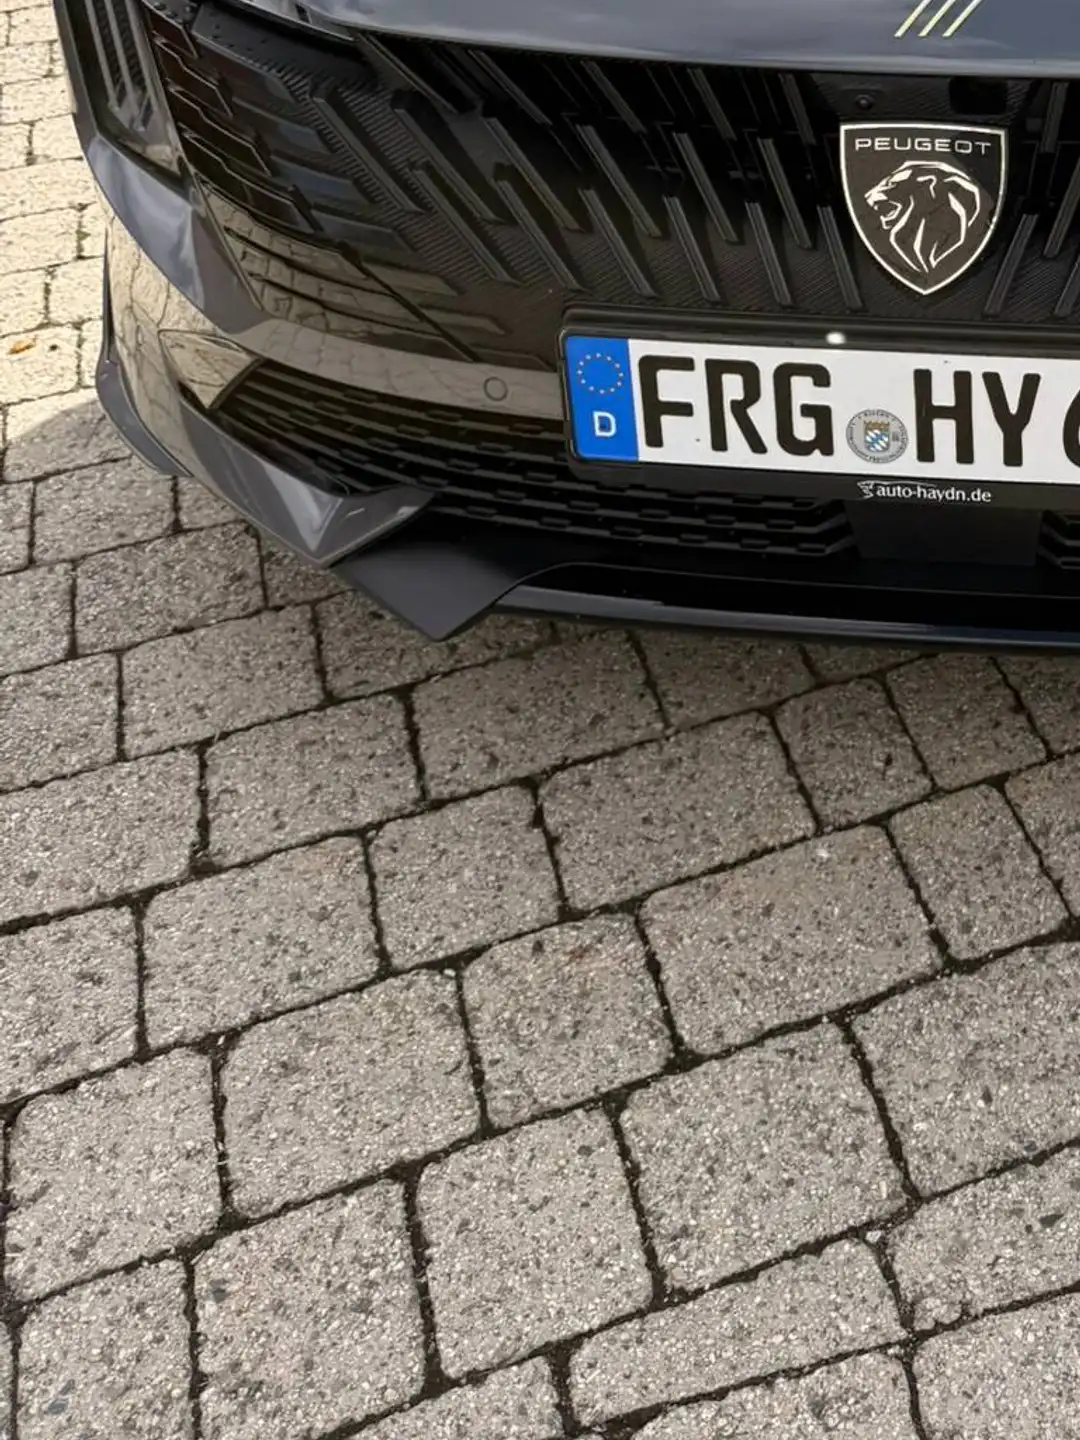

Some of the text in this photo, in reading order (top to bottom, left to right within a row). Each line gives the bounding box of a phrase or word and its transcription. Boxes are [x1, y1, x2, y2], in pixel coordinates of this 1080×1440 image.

[854, 136, 992, 156] PEUGEOT
[638, 354, 835, 458] FRG
[913, 368, 1042, 467] HY
[593, 411, 617, 438] D
[875, 483, 993, 503] auto-haydn.de
